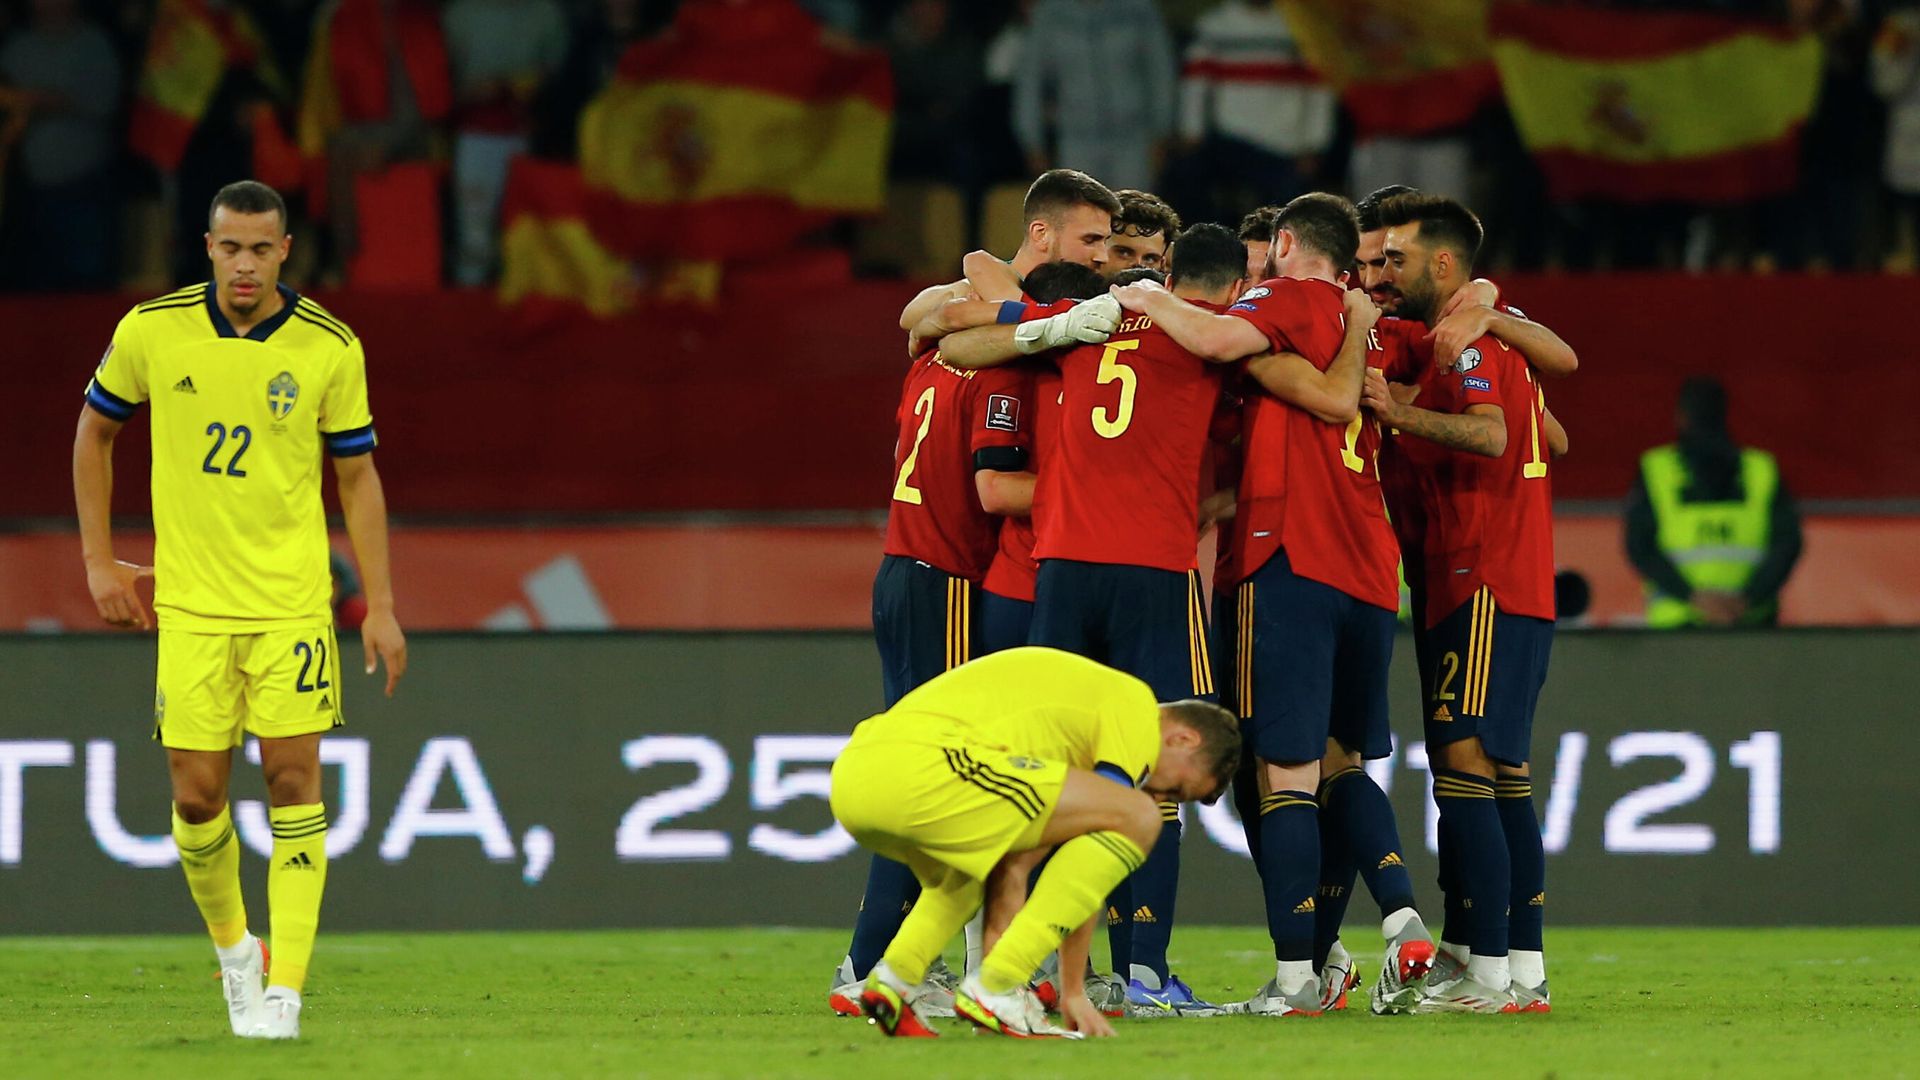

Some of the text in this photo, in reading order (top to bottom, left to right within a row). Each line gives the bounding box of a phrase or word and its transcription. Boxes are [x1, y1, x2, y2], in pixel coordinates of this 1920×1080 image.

[1119, 315, 1152, 333] GIO
[1092, 339, 1140, 438] 5
[203, 422, 251, 477] 22
[893, 387, 936, 505] 2
[295, 638, 329, 692] 22
[615, 735, 858, 862] 25
